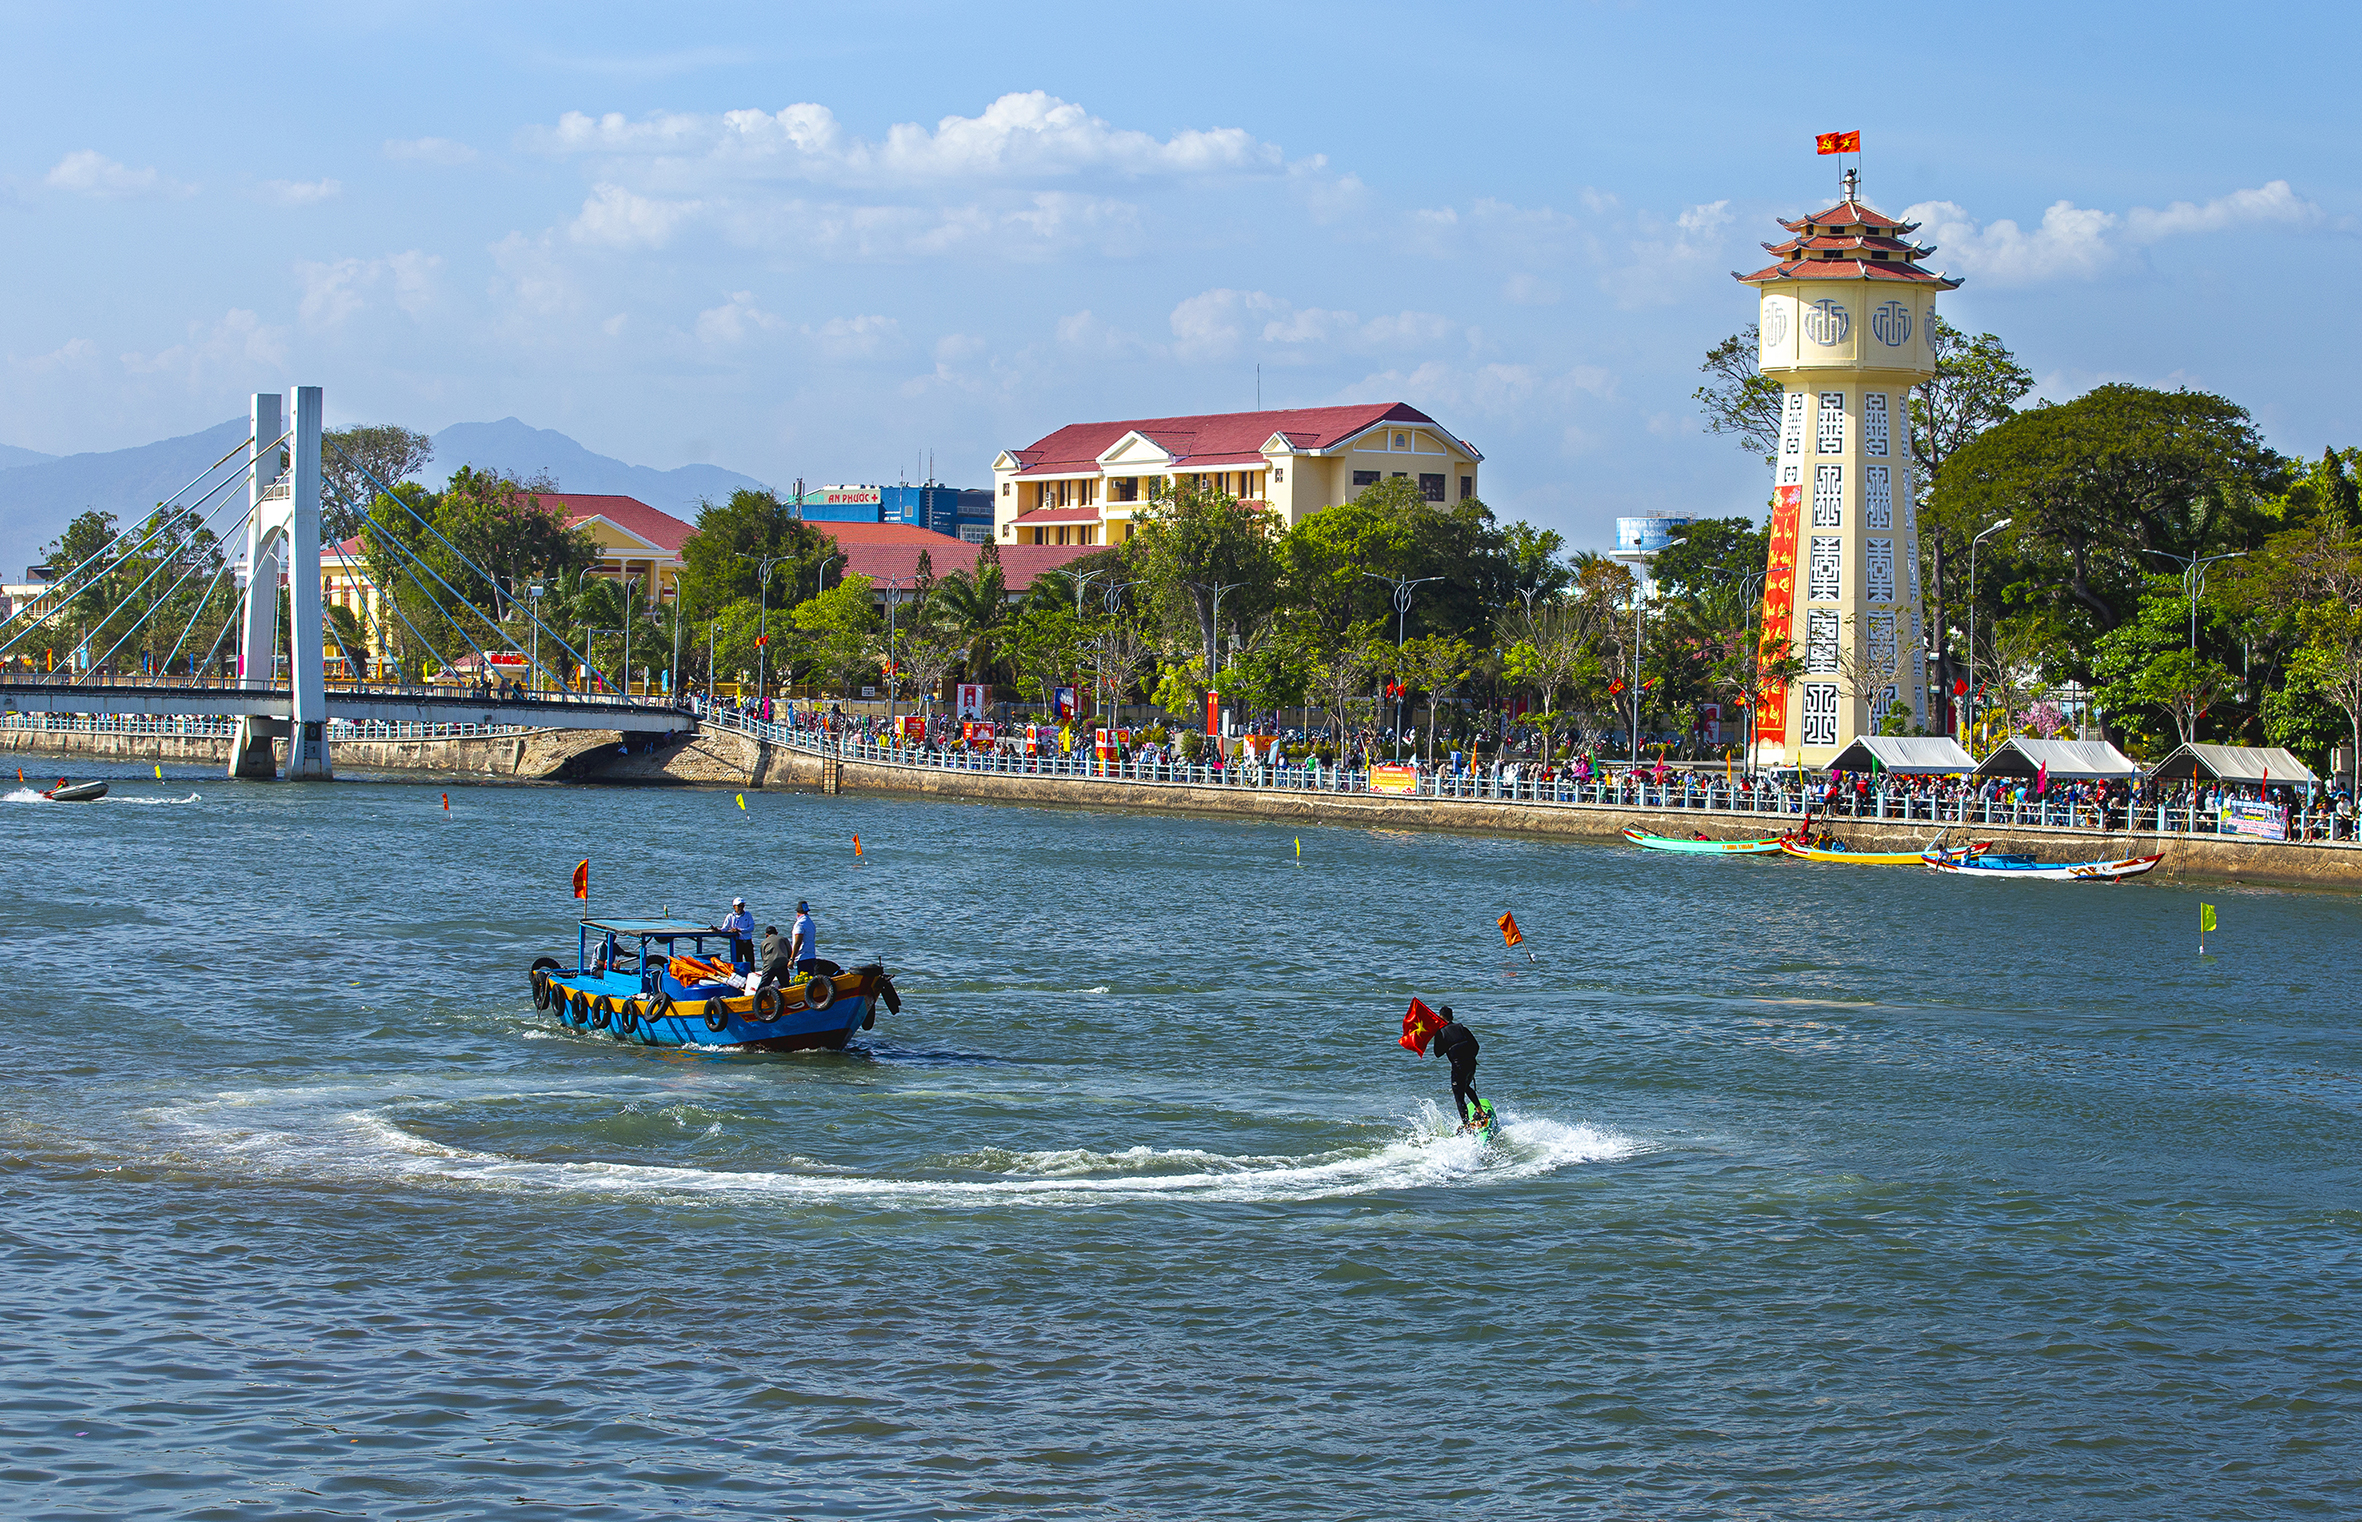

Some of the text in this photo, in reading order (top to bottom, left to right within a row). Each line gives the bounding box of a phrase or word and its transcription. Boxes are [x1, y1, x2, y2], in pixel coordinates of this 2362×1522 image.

[828, 494, 840, 504] AN
[842, 492, 869, 503] PHƯỚC
[310, 727, 317, 737] 0
